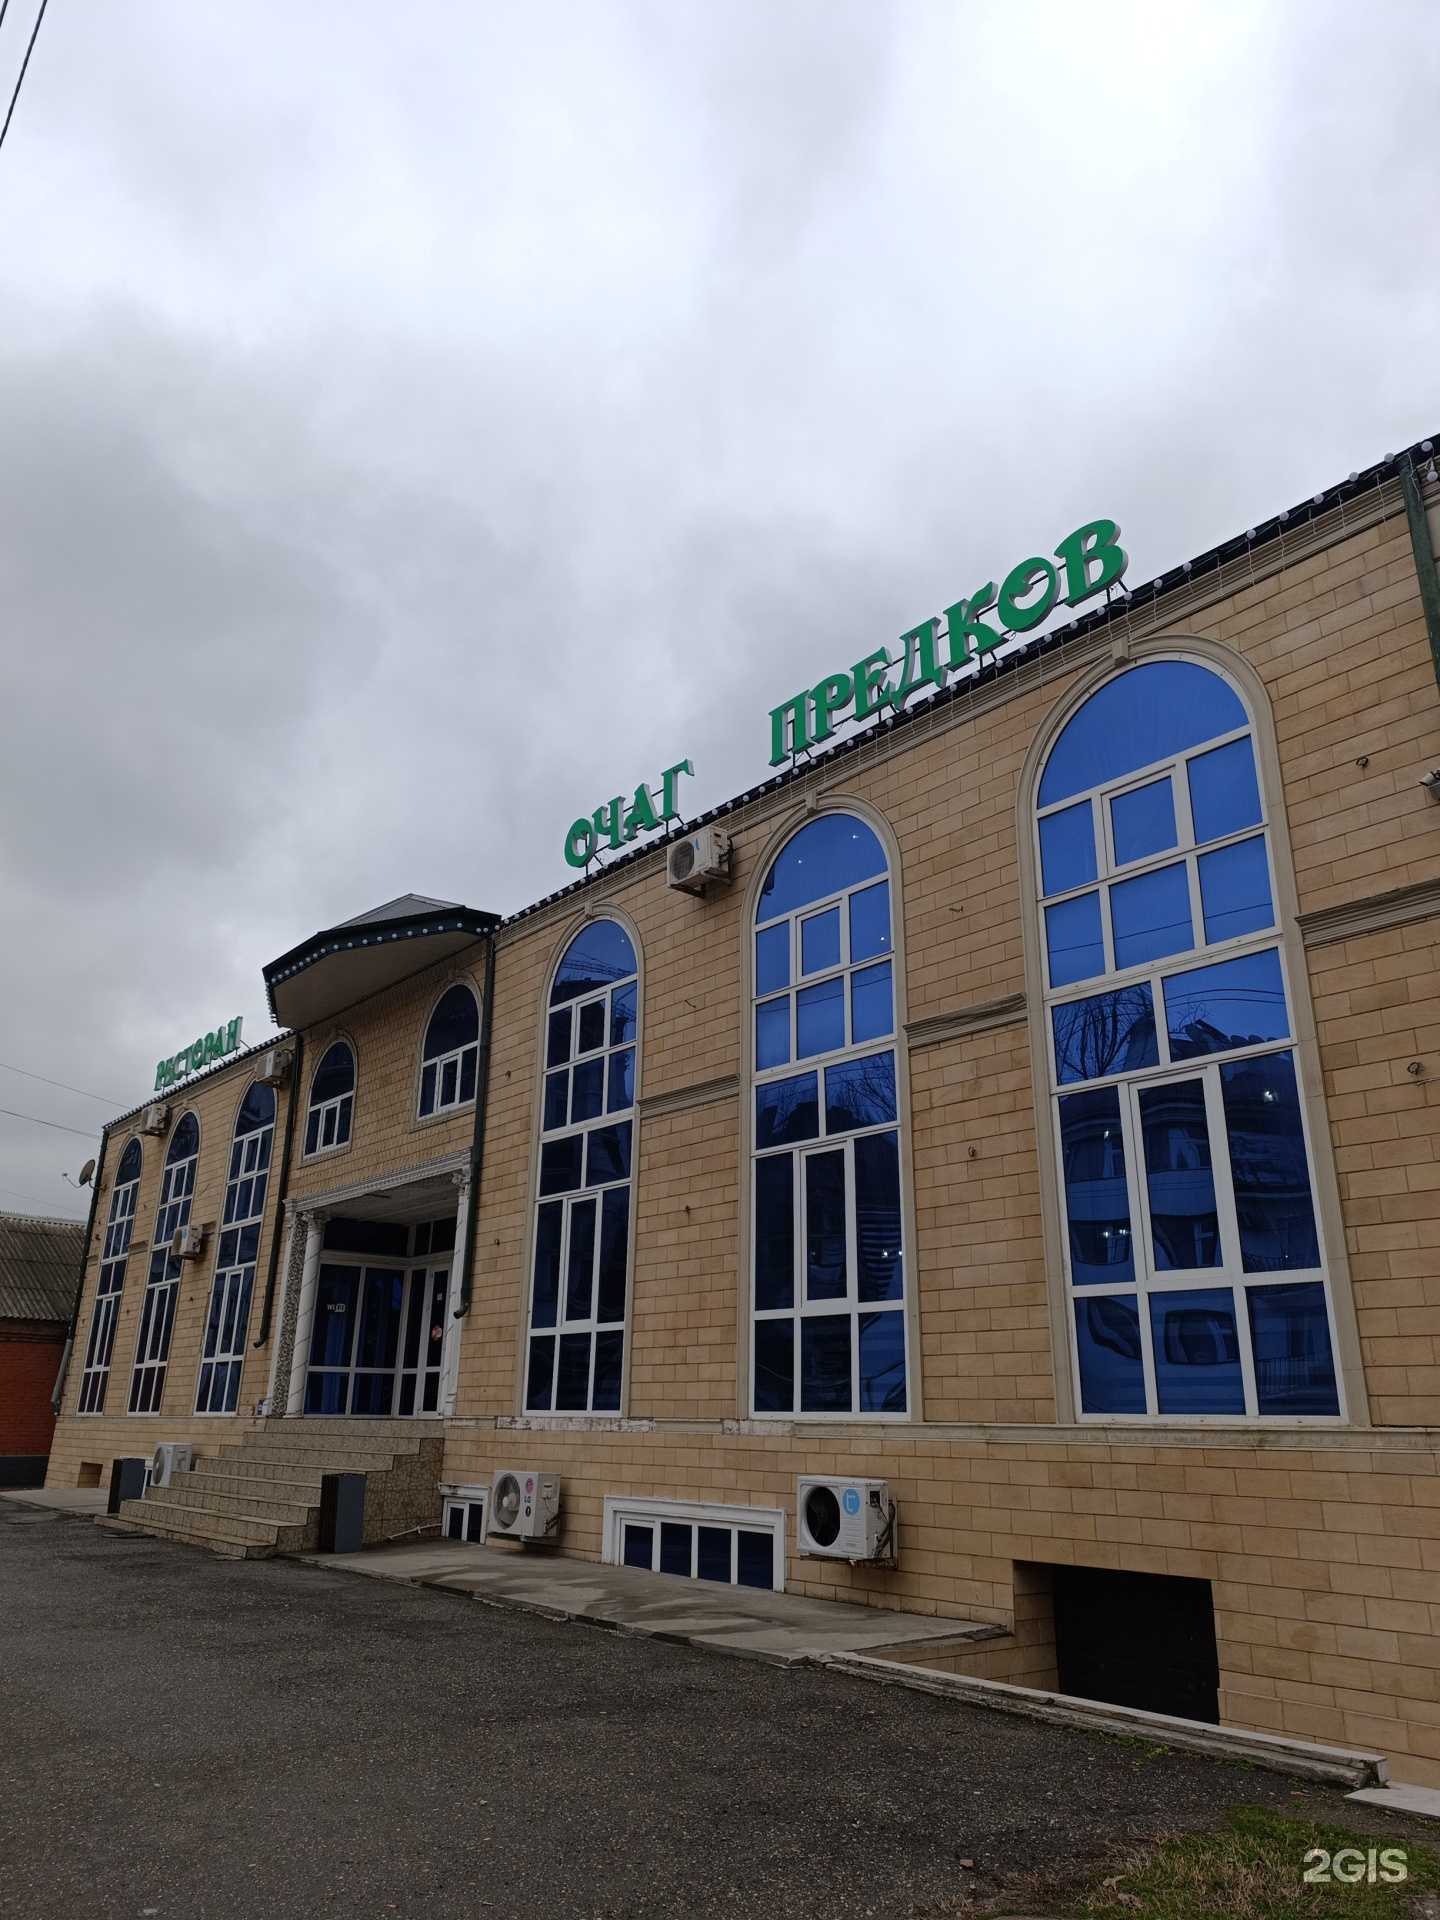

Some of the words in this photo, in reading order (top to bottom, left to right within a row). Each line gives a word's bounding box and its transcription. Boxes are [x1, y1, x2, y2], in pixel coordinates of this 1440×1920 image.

[564, 758, 694, 868] ОЧАГ
[768, 519, 1129, 767] ПРЕДКОВ
[154, 1016, 243, 1091] РЕСТОРАН
